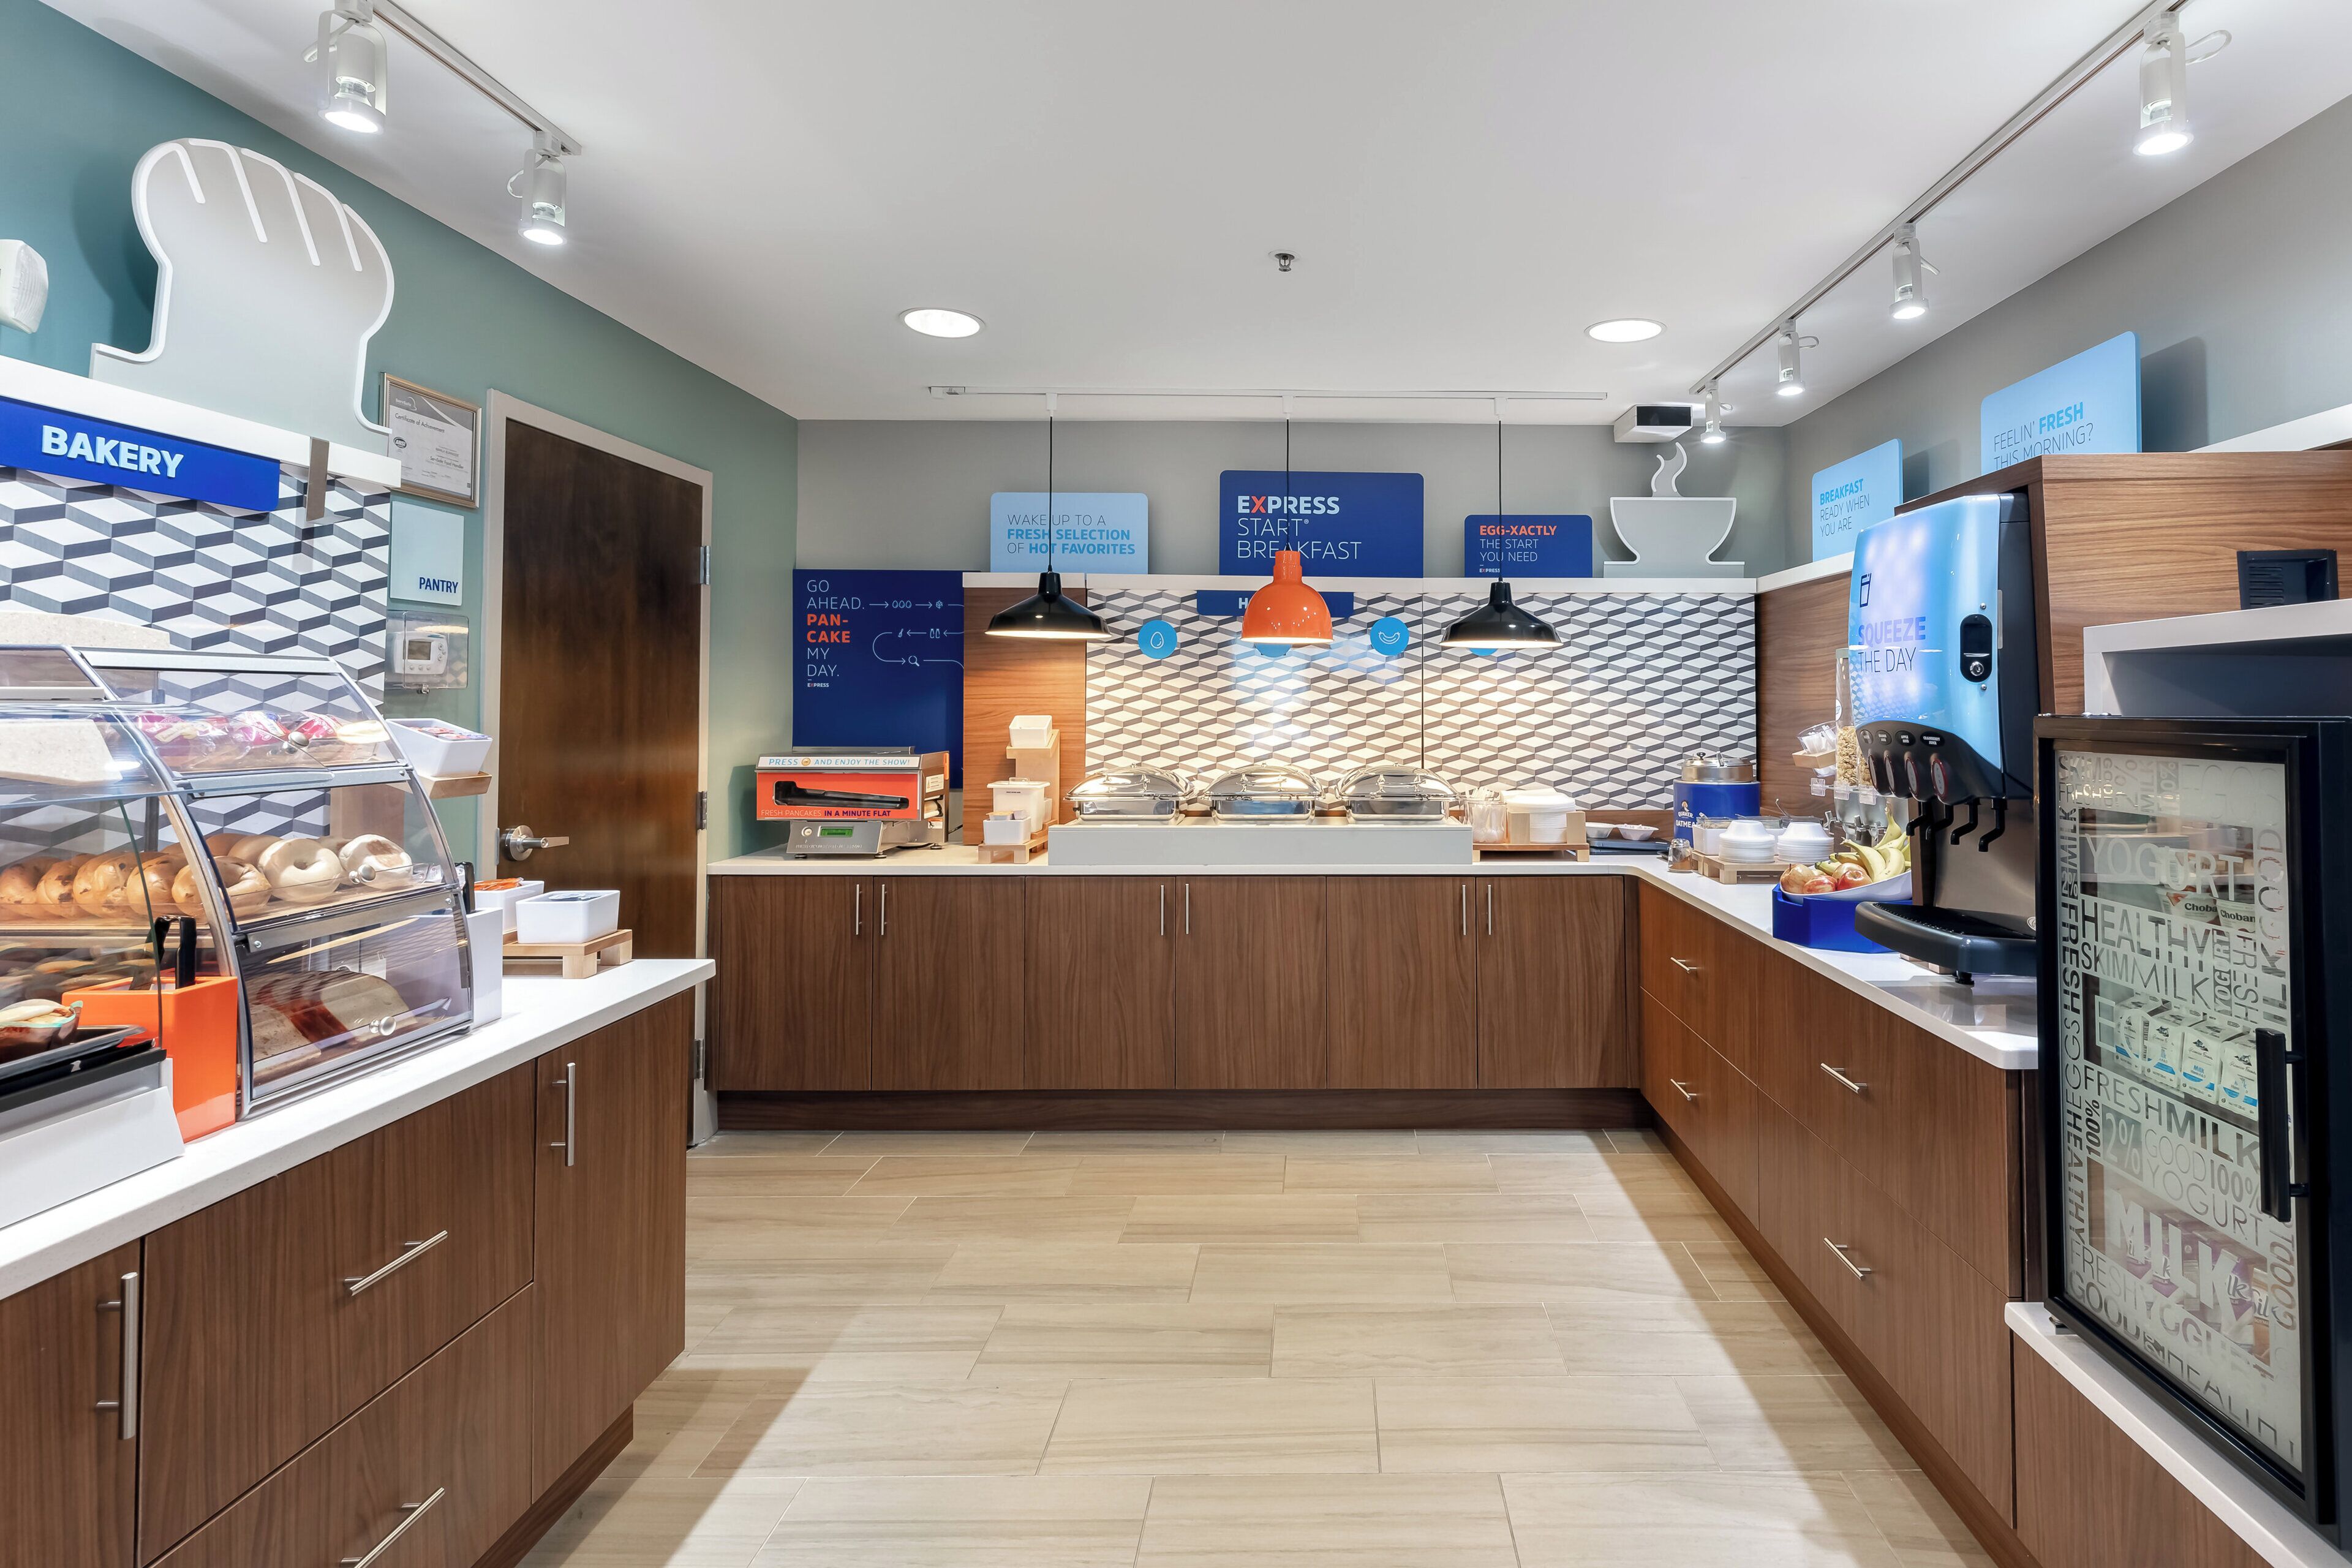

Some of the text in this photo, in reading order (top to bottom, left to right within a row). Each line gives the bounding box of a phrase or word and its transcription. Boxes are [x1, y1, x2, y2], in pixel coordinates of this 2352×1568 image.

[395, 413, 415, 424] Certificate
[1994, 401, 2084, 452] FEELIN' FRESH
[42, 424, 184, 478] BAKERY
[1994, 422, 2094, 476] THIS MORNING?
[1237, 495, 1340, 514] EXPRESS
[1820, 478, 1864, 506] BREAKFAST
[1008, 514, 1106, 526] WAKE UP TO A
[1820, 492, 1870, 522] READY WHEN
[1007, 529, 1130, 540] FRESH SELECTION
[1480, 525, 1557, 536] EGG-XACTLY
[1820, 515, 1852, 537] YOU ARE
[1007, 542, 1136, 555] OF HOT FAVORITES
[1480, 539, 1539, 549] THE START
[1480, 552, 1538, 562] YOU NEED
[419, 577, 459, 594] PANTRY
[807, 579, 829, 592] GO
[807, 597, 865, 609] AHEAD.
[807, 614, 848, 626] PAN-
[1858, 616, 1926, 646] SQUEEZE
[807, 630, 851, 643] CAKE
[807, 647, 830, 660] MY
[1858, 646, 1917, 674] THE DAY
[807, 664, 840, 677] DAY.
[2085, 833, 2244, 902] YOGURT
[2184, 902, 2217, 913] Choba
[2220, 910, 2255, 923] Choban
[2081, 899, 2211, 973] HEALTHY
[2081, 941, 2212, 1010] SKIM MILK
[2213, 930, 2233, 1016] YOGURT
[2233, 934, 2259, 1025] FRESH
[2261, 941, 2288, 1027] ILK
[2064, 1017, 2082, 1104] EGGS
[2084, 1064, 2260, 1175] FRESH MILK
[2084, 1099, 2101, 1158] 100%
[2105, 1112, 2141, 1175] 2%
[2144, 1128, 2260, 1209] GOOD 100%
[2146, 1158, 2263, 1246] YOGURT
[2071, 1238, 2138, 1311] FRESH
[2103, 1188, 2243, 1335] MILK
